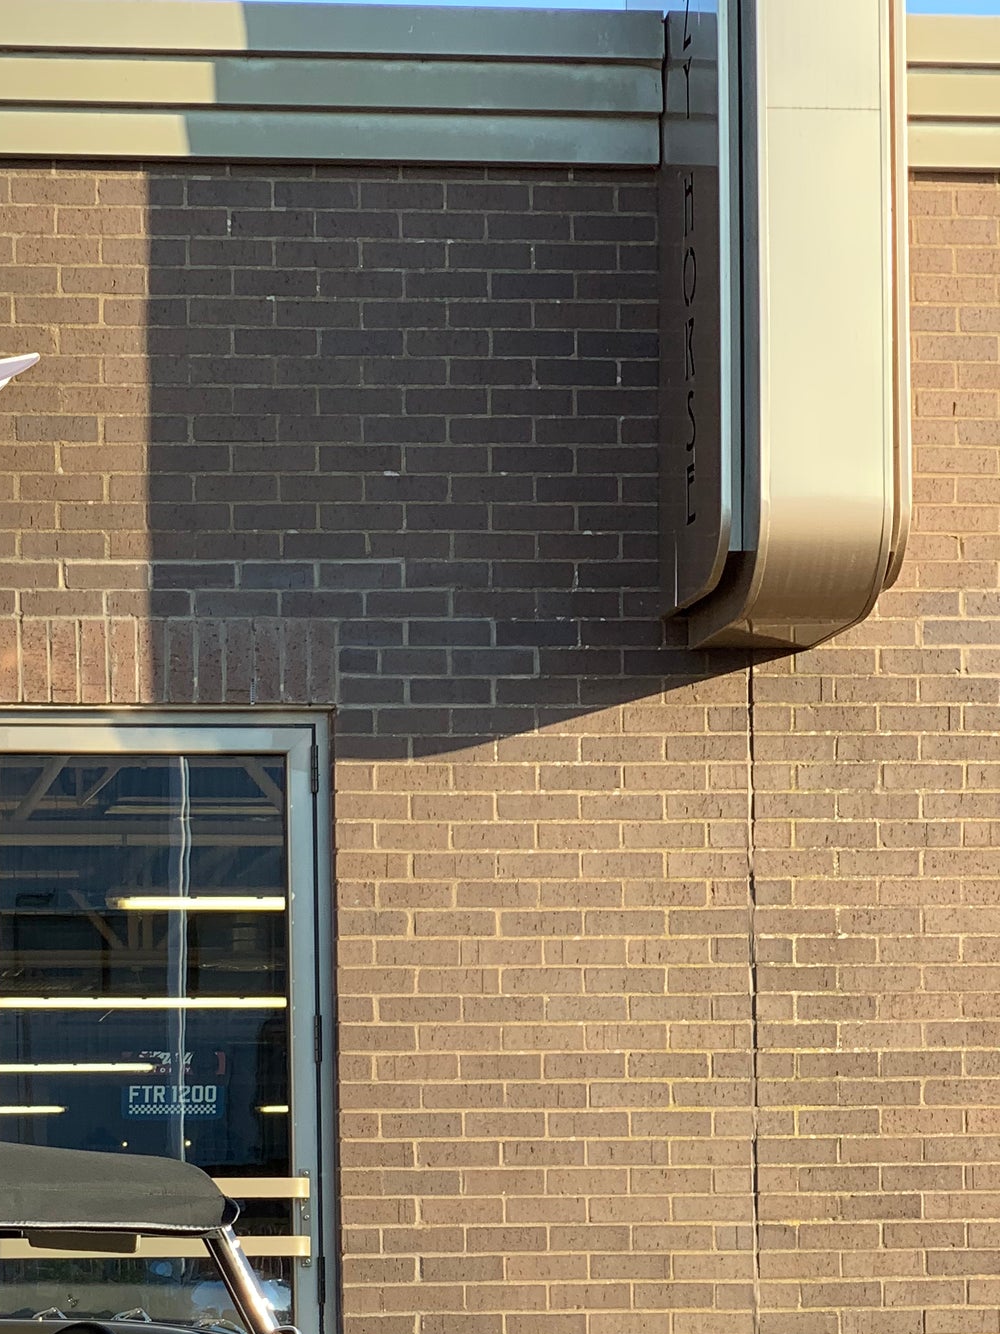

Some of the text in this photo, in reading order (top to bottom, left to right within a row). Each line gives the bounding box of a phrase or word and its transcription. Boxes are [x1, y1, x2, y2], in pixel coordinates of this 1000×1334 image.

[683, 172, 696, 526] HORSE
[128, 1085, 217, 1103] FTR 1200
